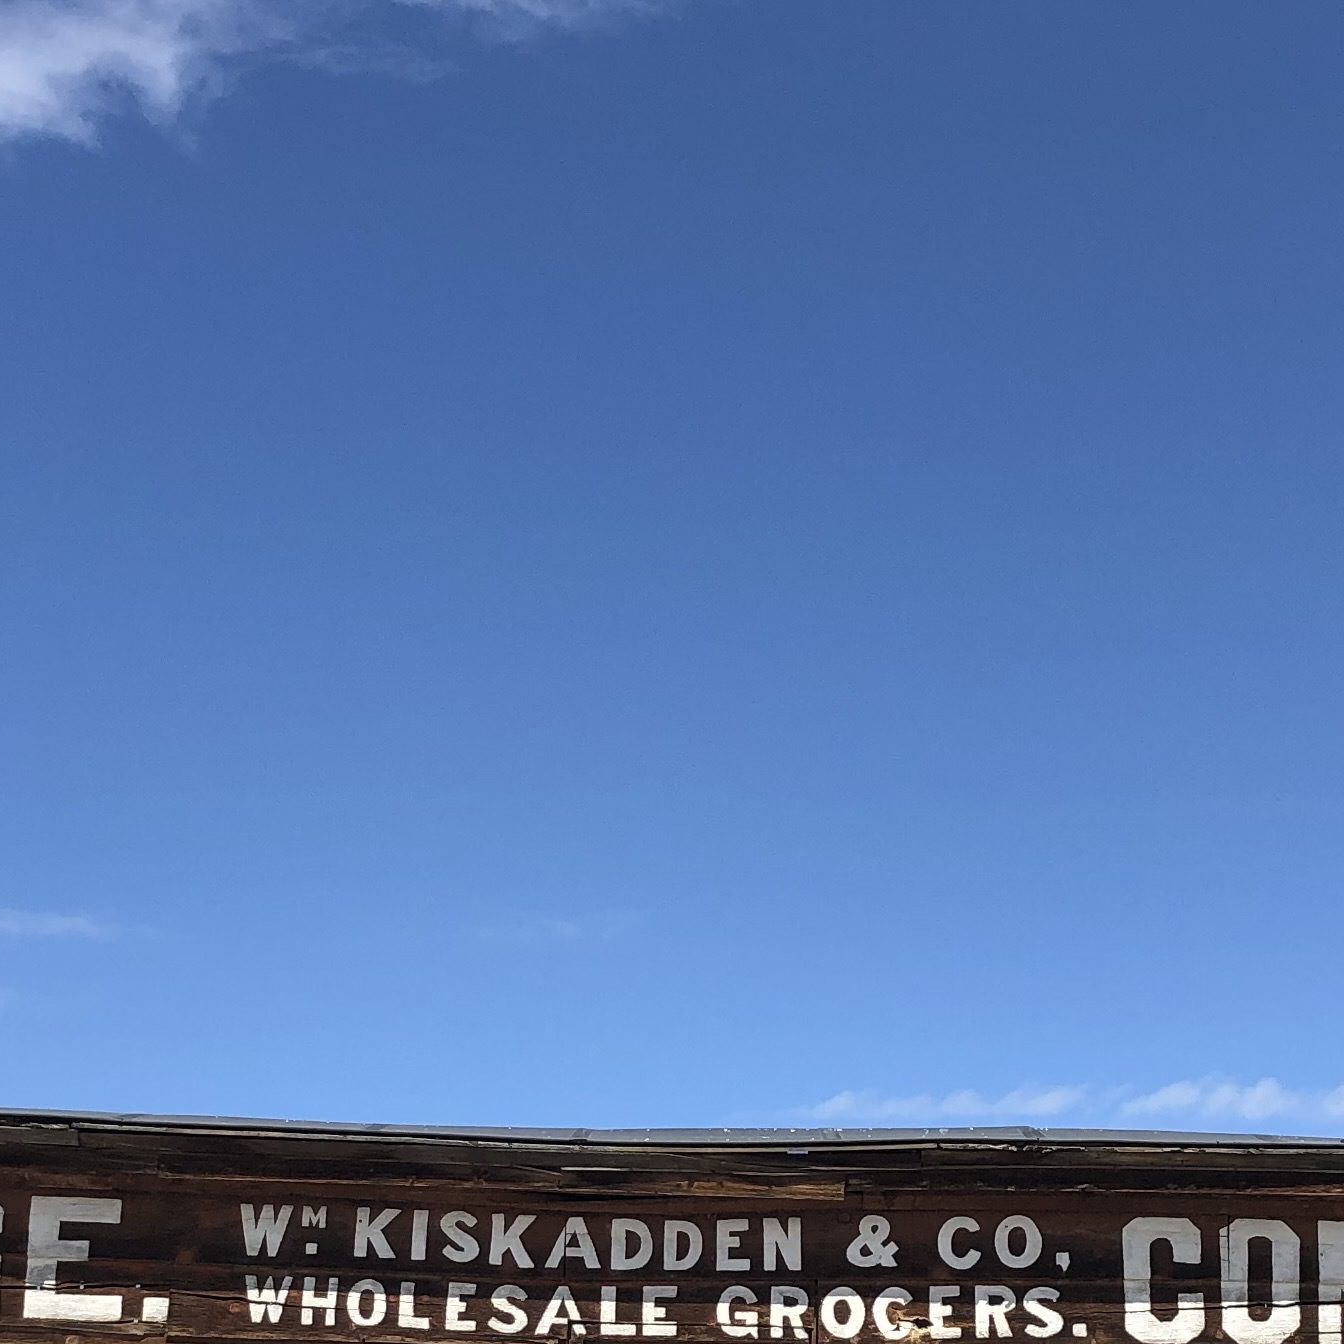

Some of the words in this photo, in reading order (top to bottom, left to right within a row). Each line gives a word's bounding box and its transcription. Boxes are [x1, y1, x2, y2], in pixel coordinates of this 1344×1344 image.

[354, 1206, 802, 1271] KISKADDEN
[846, 1214, 900, 1268] &
[245, 1275, 678, 1337] WHOLESALE
[716, 1285, 1088, 1340] GROCERS.
